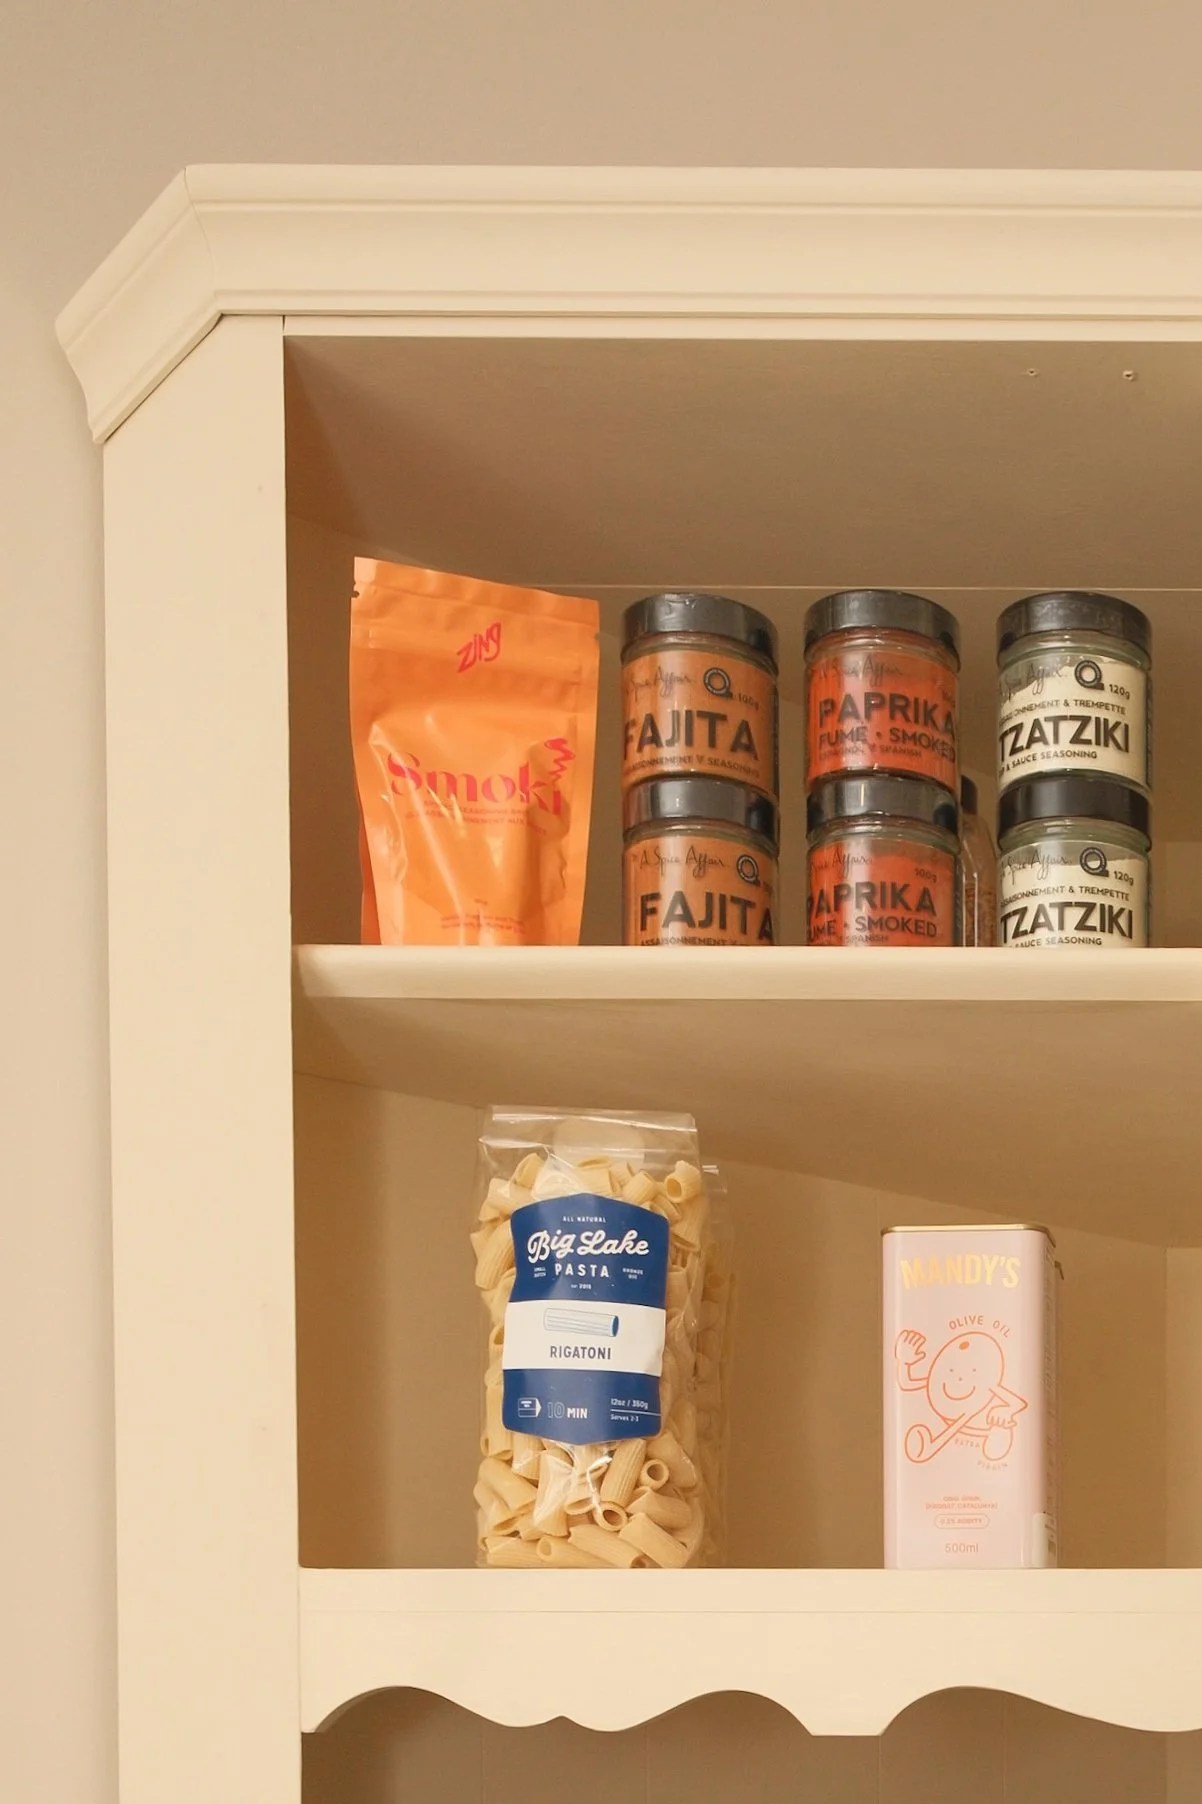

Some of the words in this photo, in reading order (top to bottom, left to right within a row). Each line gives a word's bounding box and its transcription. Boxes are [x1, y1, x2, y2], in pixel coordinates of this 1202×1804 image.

[1109, 684, 1130, 700] 120g
[1074, 699, 1126, 715] TREMPETTE
[818, 692, 955, 742] PAPRIKA
[624, 710, 759, 761] FAJITA
[1000, 715, 1129, 762] TZATZIKI
[889, 728, 956, 763] SMOKED
[1041, 750, 1098, 759] SEASONING
[1113, 871, 1134, 885] 120g
[1079, 886, 1130, 901] TREMPETTE
[640, 890, 774, 941] FAJITA
[1001, 902, 1133, 944] TZATZIKI
[855, 916, 937, 938] SMOKED
[1046, 937, 1102, 946] SEASONING
[527, 1229, 576, 1263] Big
[577, 1229, 649, 1256] Lake
[555, 1263, 609, 1278] PASTA
[900, 1253, 1021, 1290] MANDY'S
[949, 1315, 984, 1330] OLIVE
[992, 1320, 1011, 1338] OIL
[550, 1345, 611, 1360] RIGATONI
[547, 1402, 565, 1418] 10
[567, 1408, 588, 1419] MIN
[945, 1543, 979, 1553] 500ml
